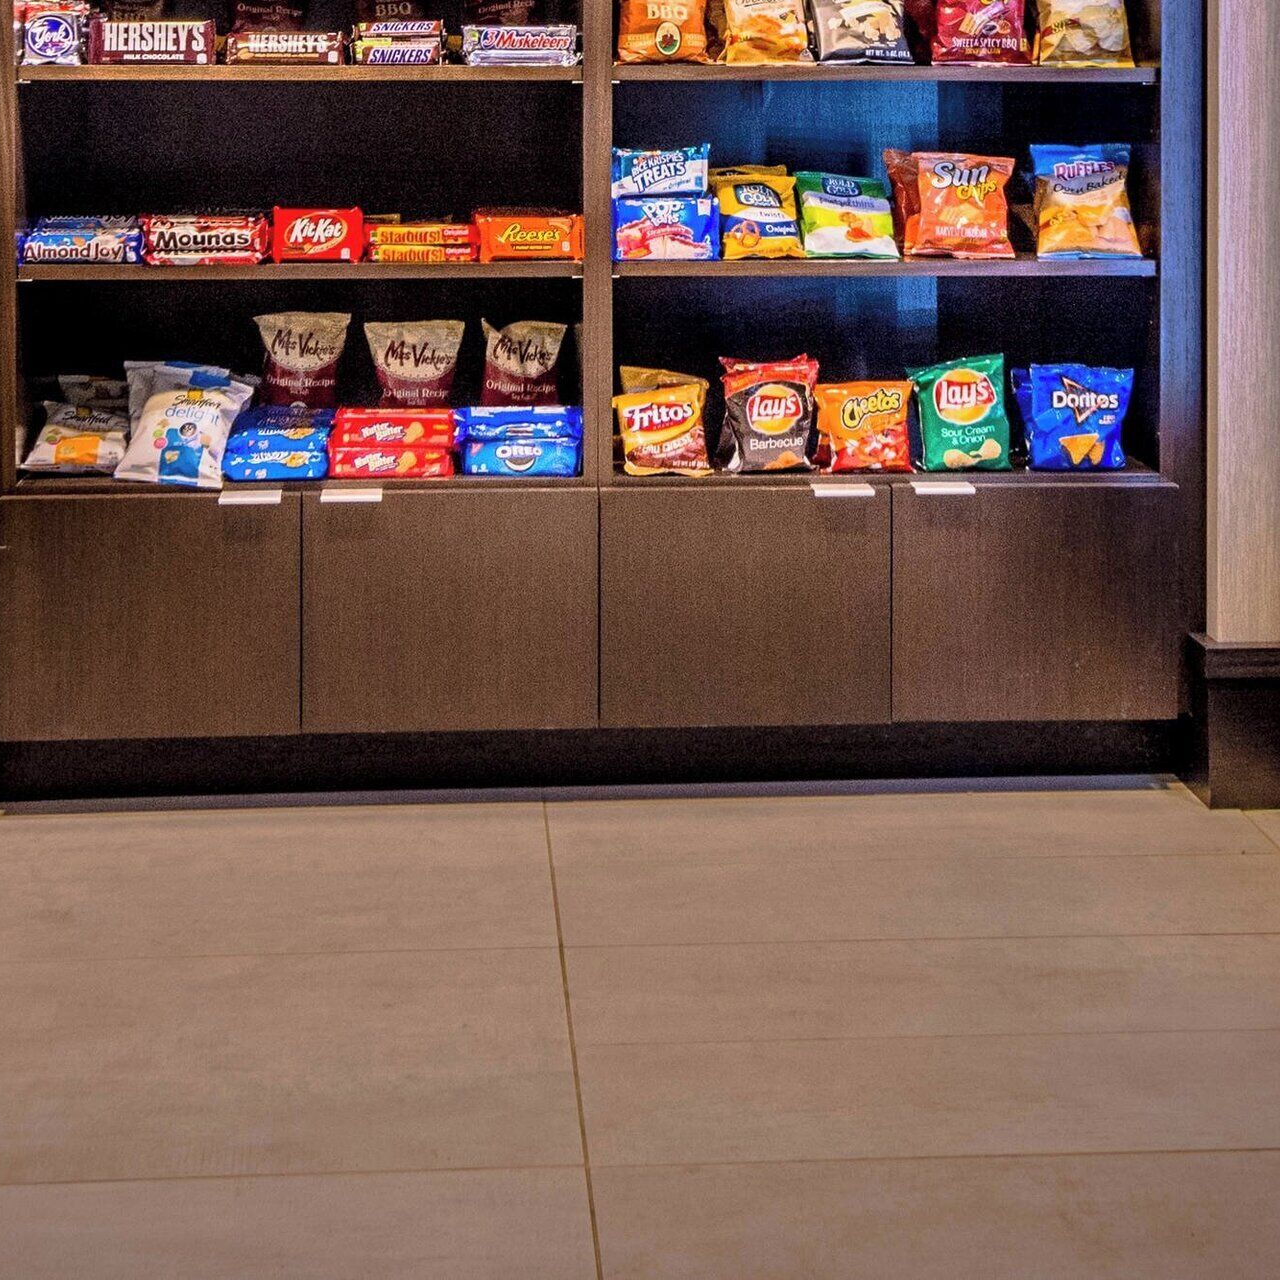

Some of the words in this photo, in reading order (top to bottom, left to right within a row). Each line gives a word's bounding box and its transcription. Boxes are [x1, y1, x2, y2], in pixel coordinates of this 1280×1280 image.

[375, 2, 412, 16] BBQ
[646, 4, 688, 20] BBQ
[103, 22, 206, 51] HERSHEY'S
[371, 22, 434, 32] SNICKERS
[35, 26, 71, 49] York
[249, 33, 329, 53] HERSHEY'S
[485, 31, 496, 45] 3
[496, 29, 570, 49] Musketeers
[123, 53, 141, 61] MILK
[142, 53, 185, 61] CHOCOLATE
[369, 49, 432, 64] SNICKERS
[648, 152, 685, 167] KRISPIES
[633, 162, 686, 193] TREATS
[932, 162, 990, 189] Sun
[1054, 161, 1115, 181] RUFFLES
[827, 178, 855, 189] ROLD
[956, 180, 998, 201] Chips
[1053, 182, 1085, 194] Oven
[1086, 172, 1126, 191] Baked
[740, 192, 780, 208] GOLD
[496, 222, 561, 243] Reese's
[765, 223, 796, 234] Original
[154, 230, 251, 250] Mounds
[23, 240, 90, 261] Almond
[93, 241, 123, 262] Joy
[445, 247, 471, 255] Original
[486, 380, 524, 393] Original
[939, 379, 990, 409] Lay's
[750, 396, 796, 421] Lay's
[842, 388, 902, 429] Cheetos
[1053, 391, 1119, 409] Doritos
[165, 406, 219, 426] delight
[623, 401, 694, 433] Fritos
[941, 426, 963, 438] Sour
[964, 424, 995, 436] Cream
[959, 434, 986, 445] Onion
[496, 446, 542, 459] OREO
[750, 436, 804, 451] Barbecue
